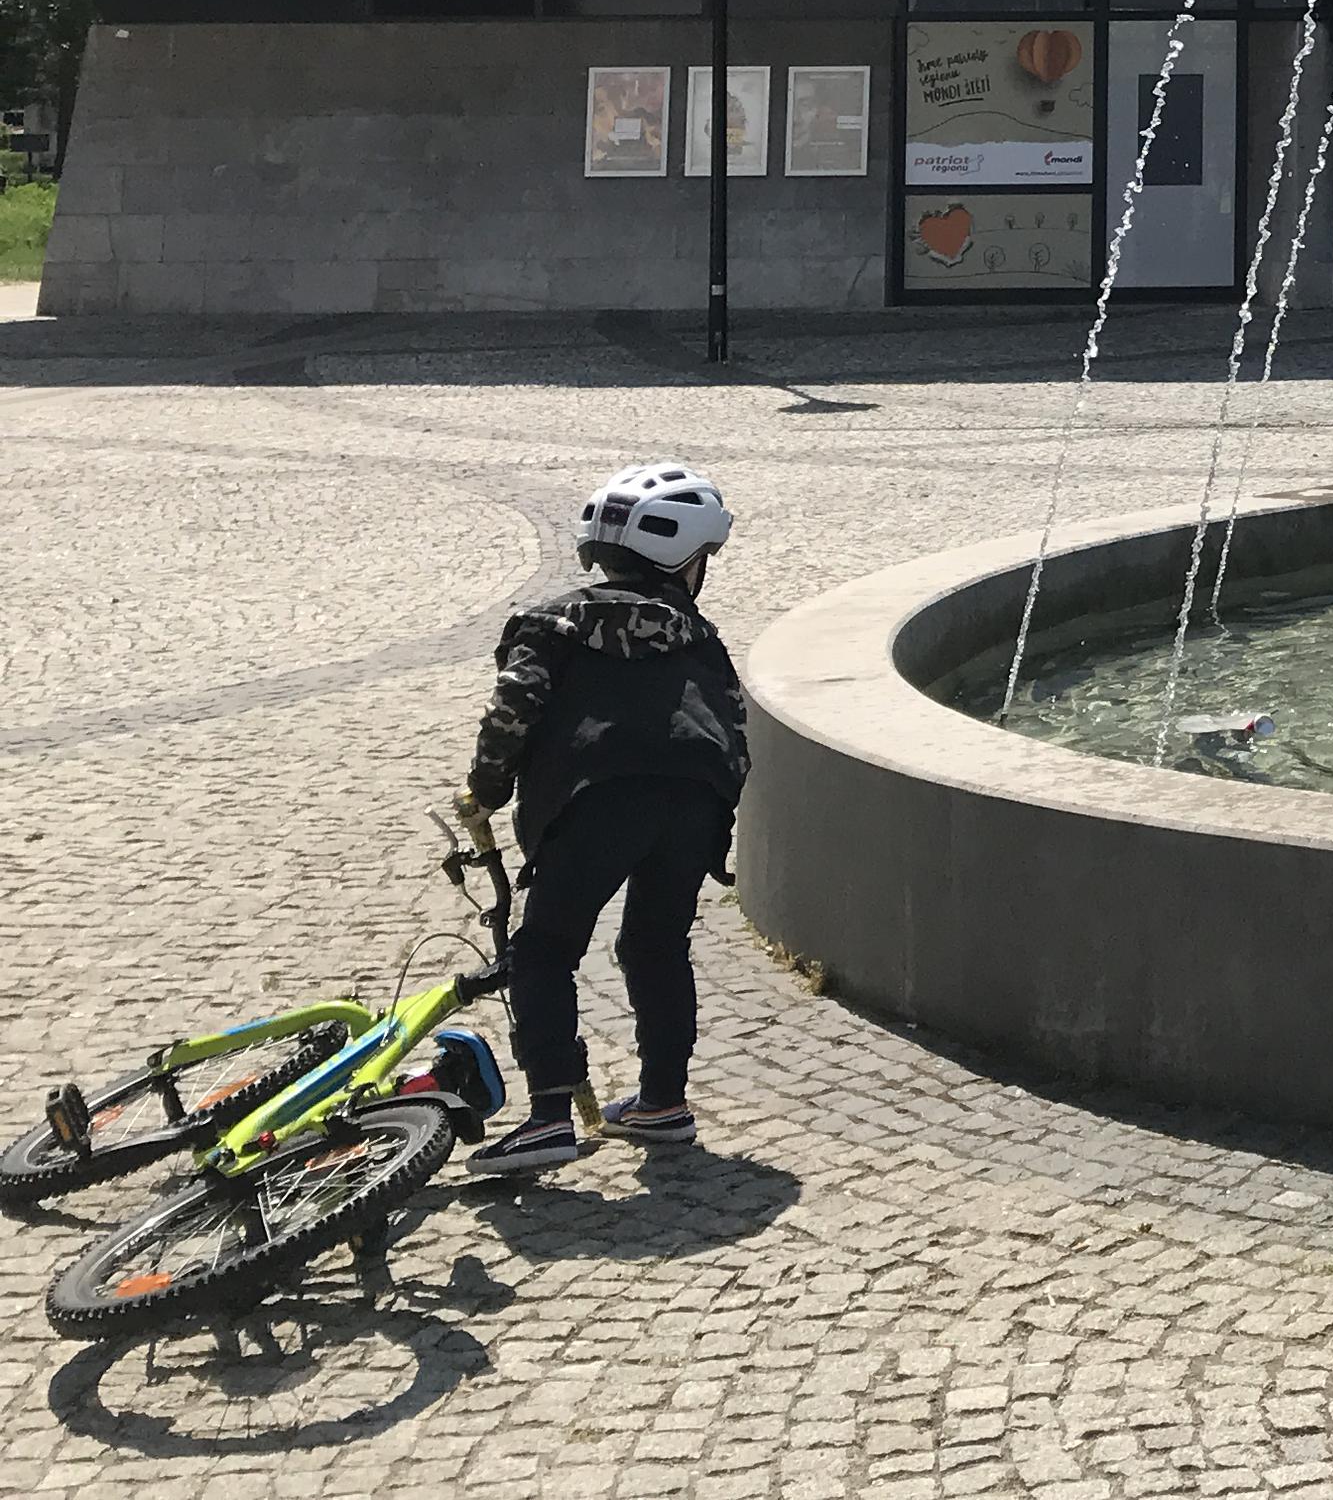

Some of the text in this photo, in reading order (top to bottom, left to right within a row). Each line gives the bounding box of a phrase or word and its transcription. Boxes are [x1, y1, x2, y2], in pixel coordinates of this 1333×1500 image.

[923, 84, 961, 103] MONDI
[914, 154, 971, 166] patriot
[1050, 155, 1083, 164] mondi
[931, 163, 969, 173] regionu
